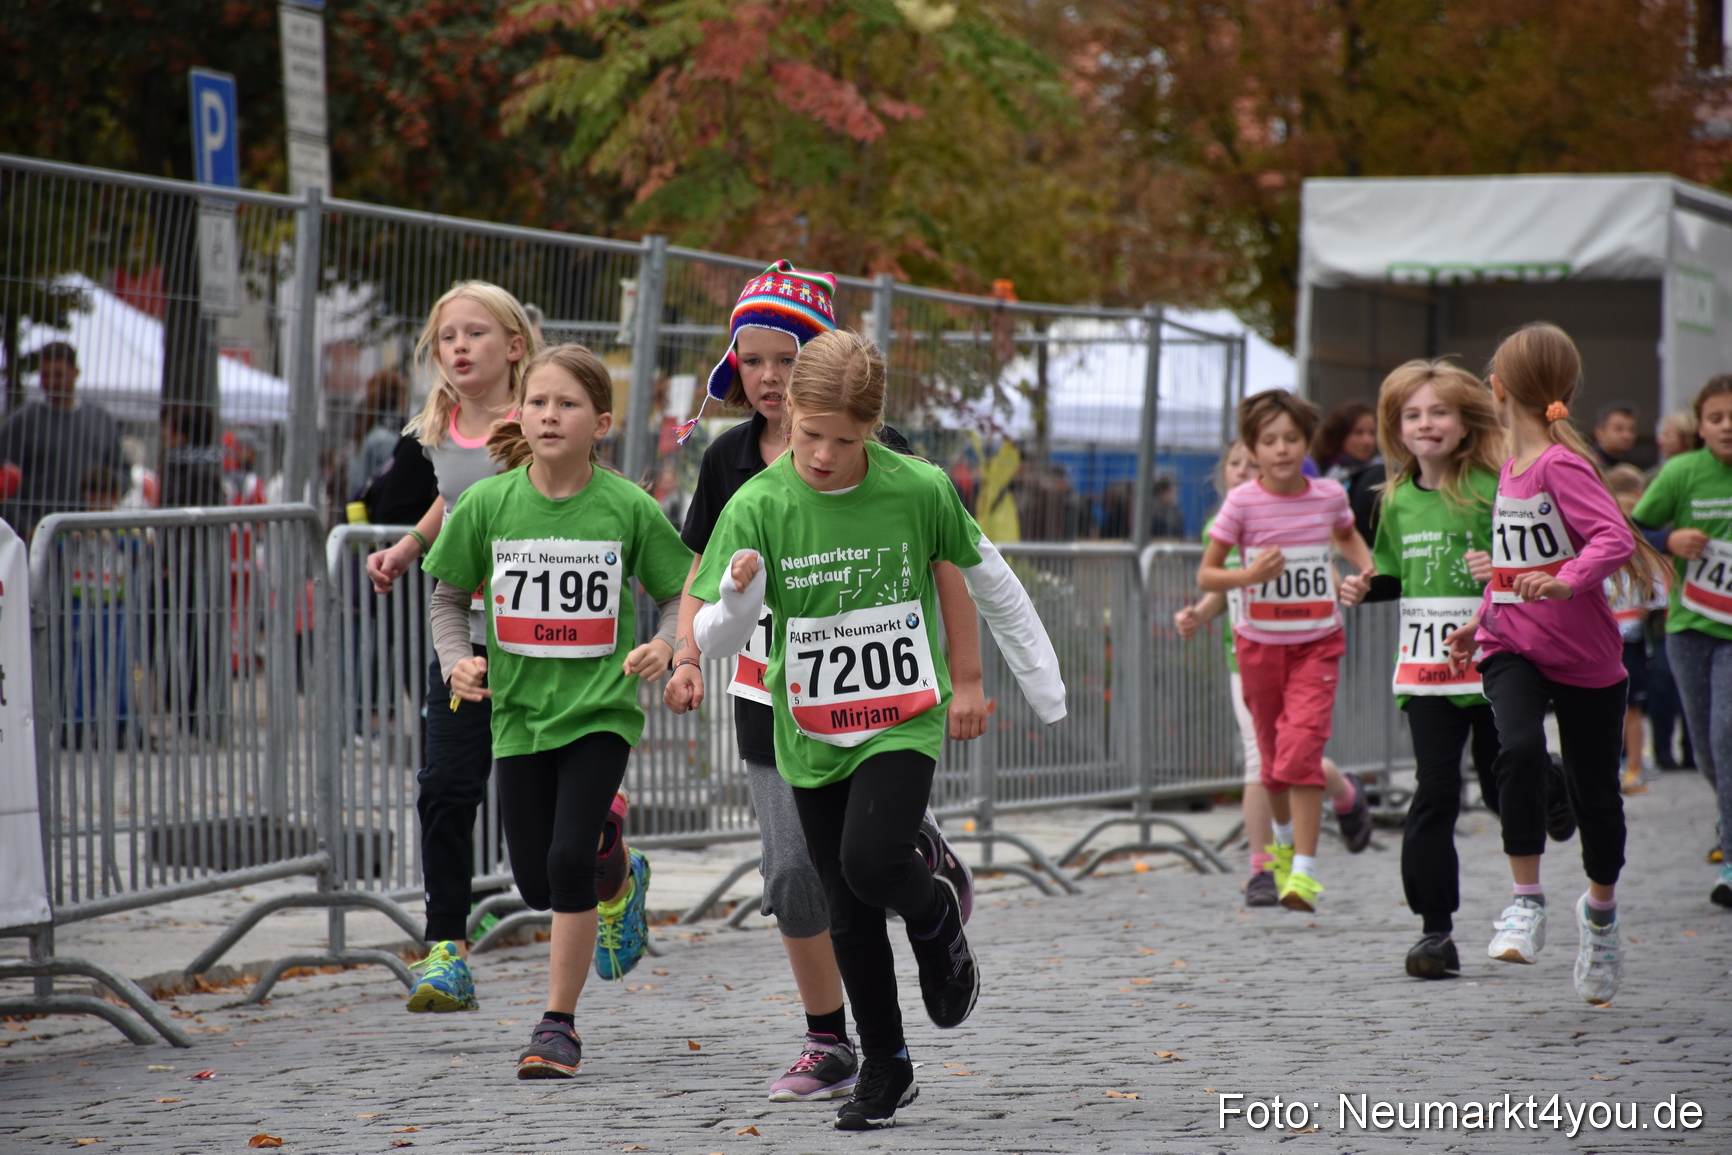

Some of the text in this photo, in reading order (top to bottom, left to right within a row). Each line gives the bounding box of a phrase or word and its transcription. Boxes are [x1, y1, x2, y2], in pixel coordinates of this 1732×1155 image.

[201, 88, 227, 184] P
[1402, 530, 1443, 544] umarkter
[1497, 523, 1560, 561] 170
[496, 552, 536, 564] PARTL
[539, 553, 600, 564] Neumarkt
[780, 547, 871, 571] Neumarkter
[902, 542, 911, 603] BAMBI
[1499, 573, 1514, 588] Le
[505, 570, 609, 613] 7196
[498, 606, 613, 616] 5 K
[1274, 607, 1311, 617] Emma
[1402, 607, 1473, 618] PARTL Neumarkt
[534, 623, 578, 642] Carla
[790, 619, 902, 644] PARTL Neumarkt
[1409, 622, 1468, 658] 719
[797, 637, 920, 698] 7206
[921, 679, 929, 688] K
[794, 695, 801, 706] 5
[830, 705, 900, 729] Mirjam
